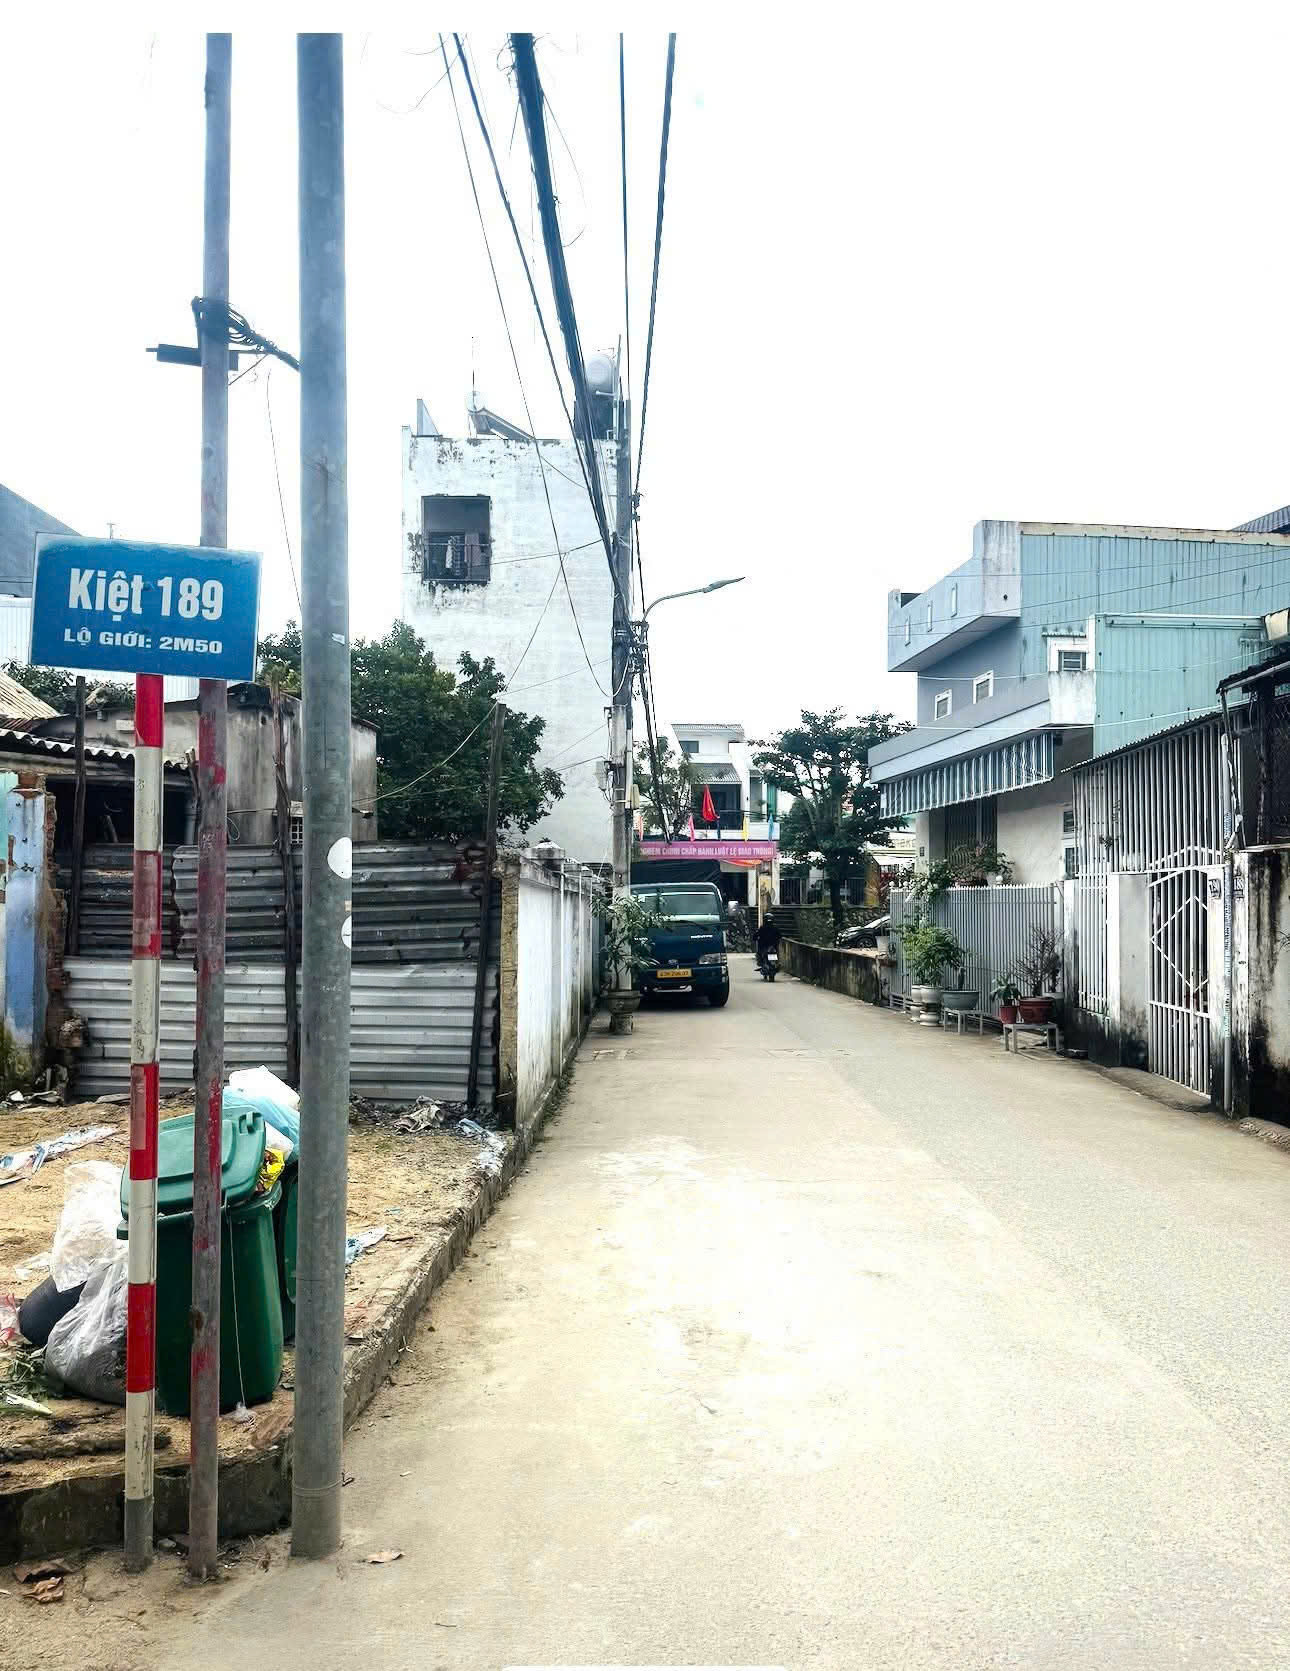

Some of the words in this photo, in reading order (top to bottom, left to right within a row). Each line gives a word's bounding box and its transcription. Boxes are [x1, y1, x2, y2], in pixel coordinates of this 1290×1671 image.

[68, 567, 145, 622] Kiệt
[156, 575, 224, 621] 189
[63, 626, 92, 646] LỘ
[99, 630, 152, 649] GIỚI:
[159, 636, 223, 654] 2M50
